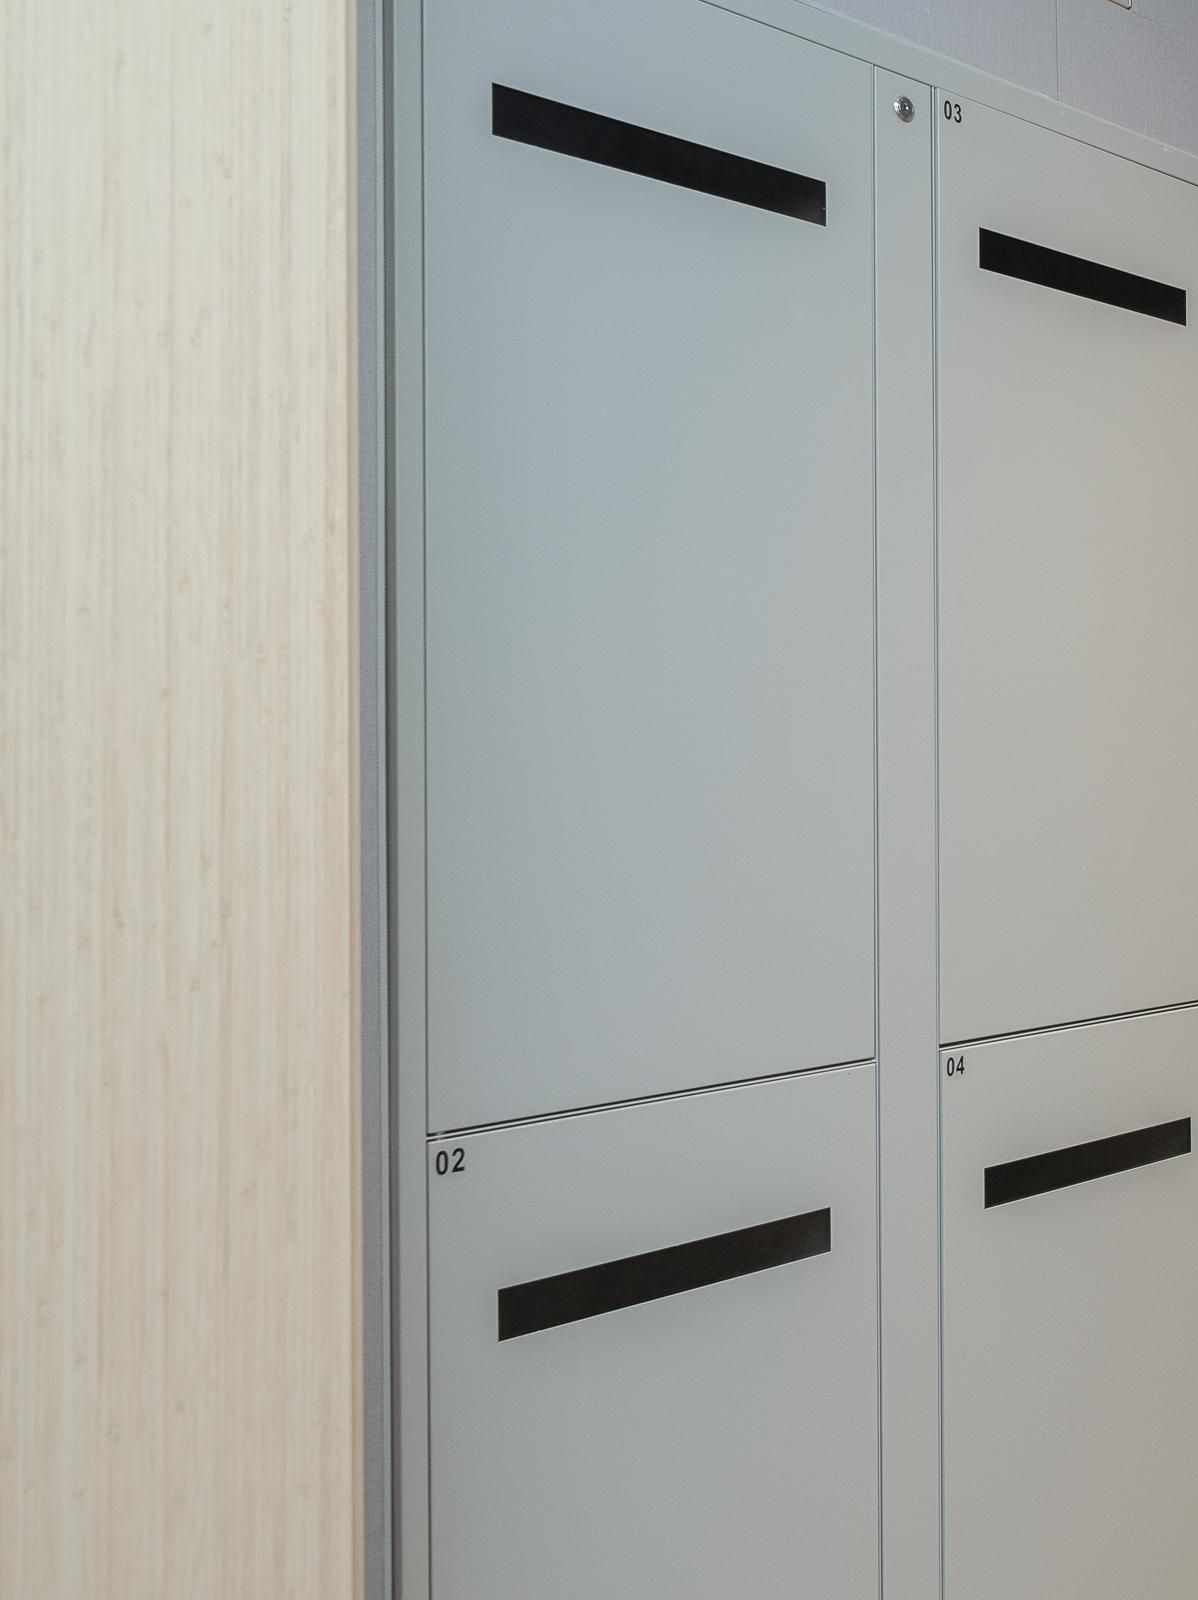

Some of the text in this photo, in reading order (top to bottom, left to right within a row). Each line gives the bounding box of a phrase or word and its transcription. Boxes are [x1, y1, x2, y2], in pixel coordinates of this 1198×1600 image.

[943, 100, 962, 124] 03
[946, 1055, 965, 1077] 04
[435, 1147, 466, 1176] 02
